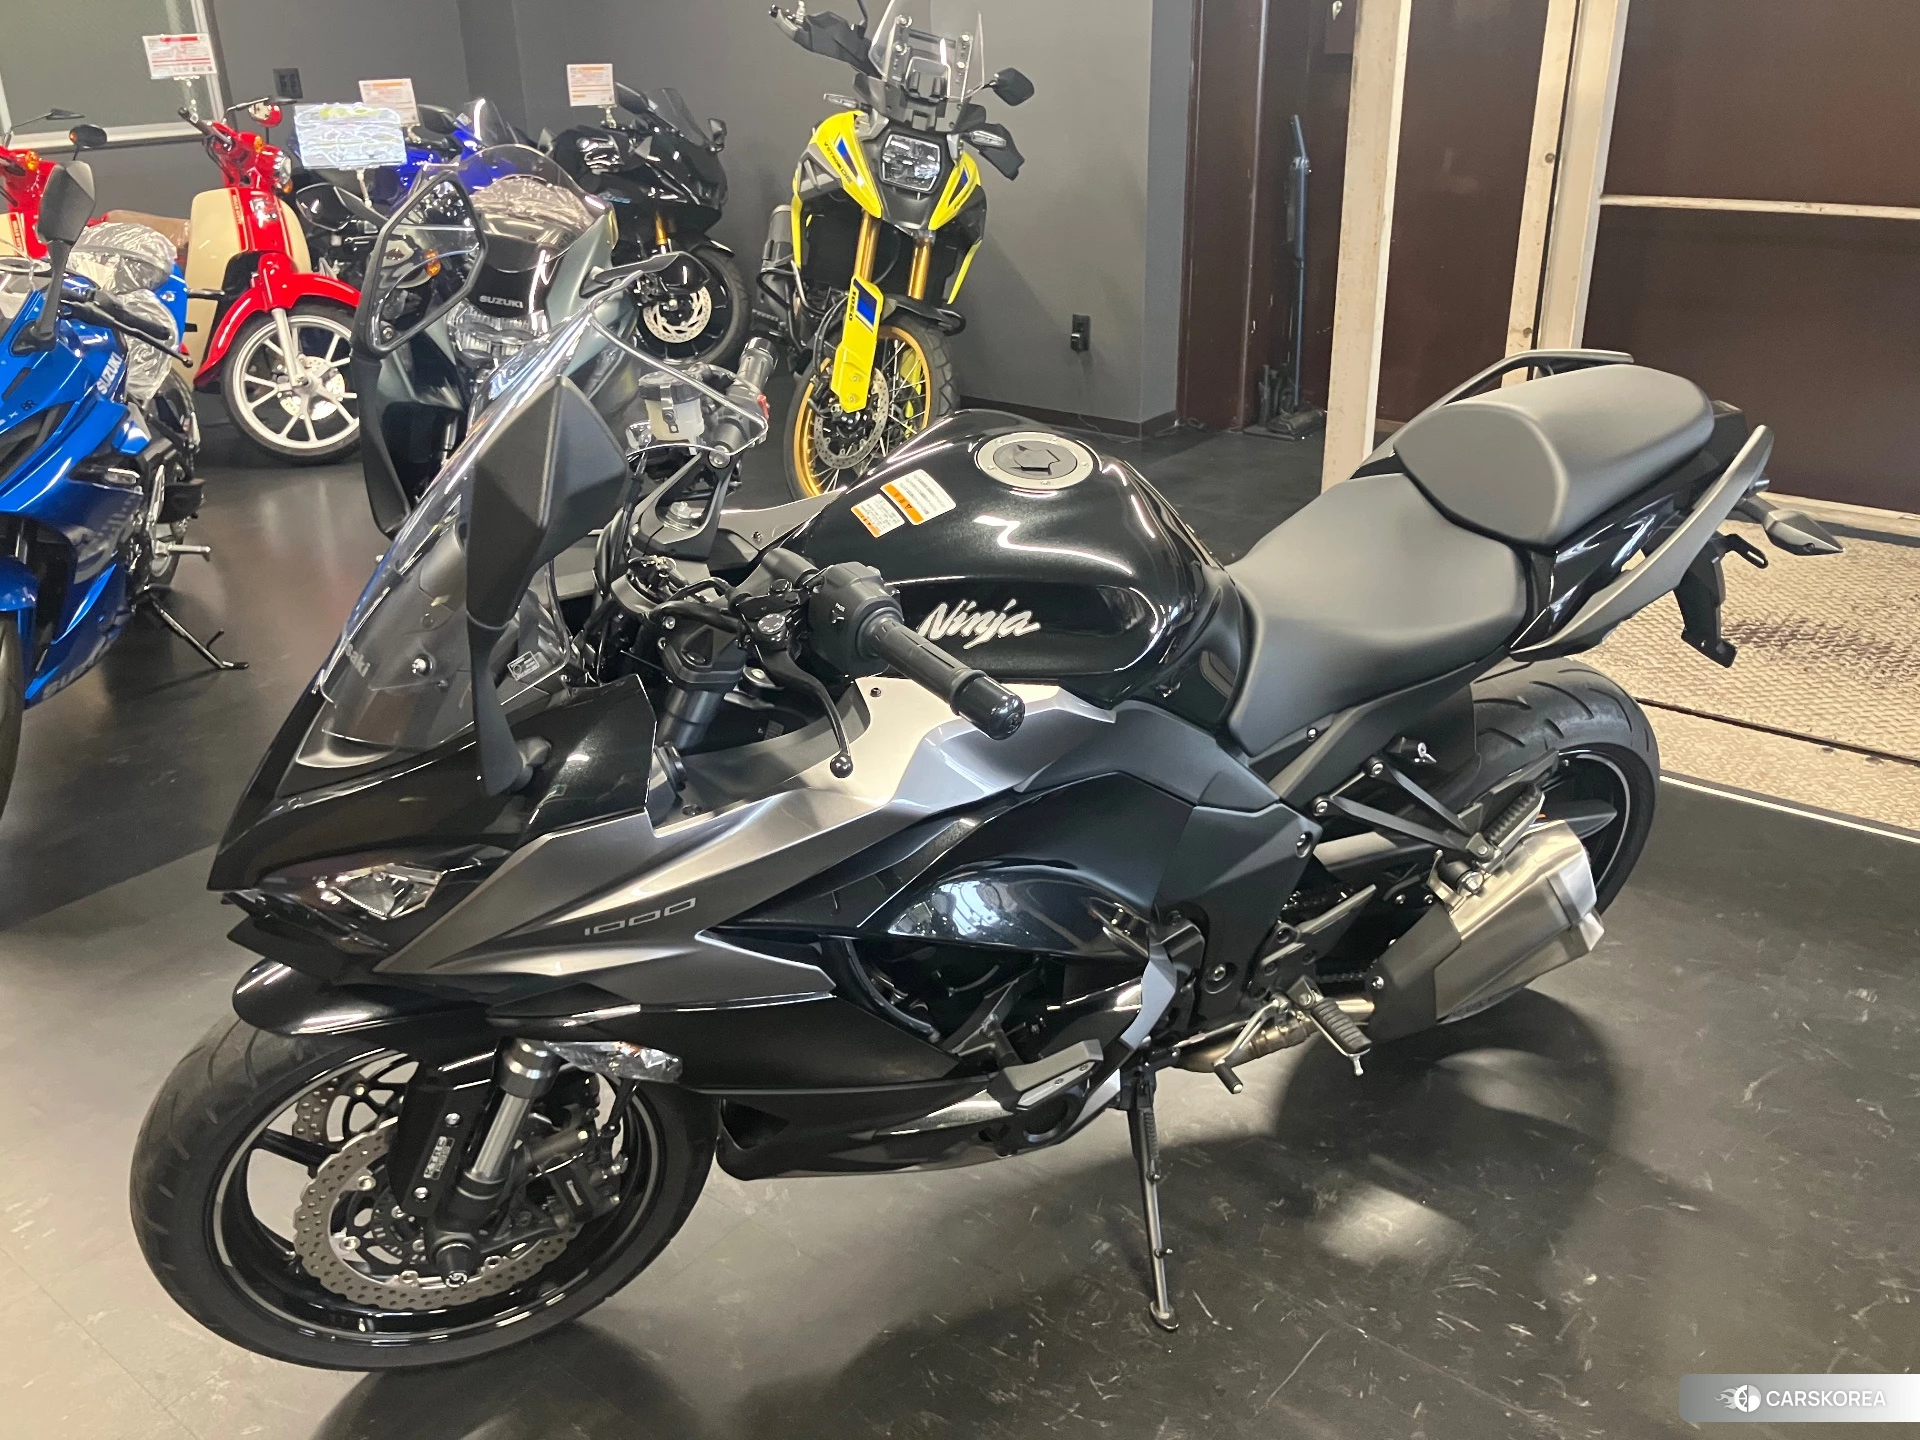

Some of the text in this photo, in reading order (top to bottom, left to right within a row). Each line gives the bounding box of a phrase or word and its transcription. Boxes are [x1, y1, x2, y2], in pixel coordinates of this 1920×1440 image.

[479, 295, 524, 309] SUZUKI
[96, 351, 123, 395] SUZUKI
[916, 598, 1041, 650] Ninja
[584, 897, 697, 936] 1000
